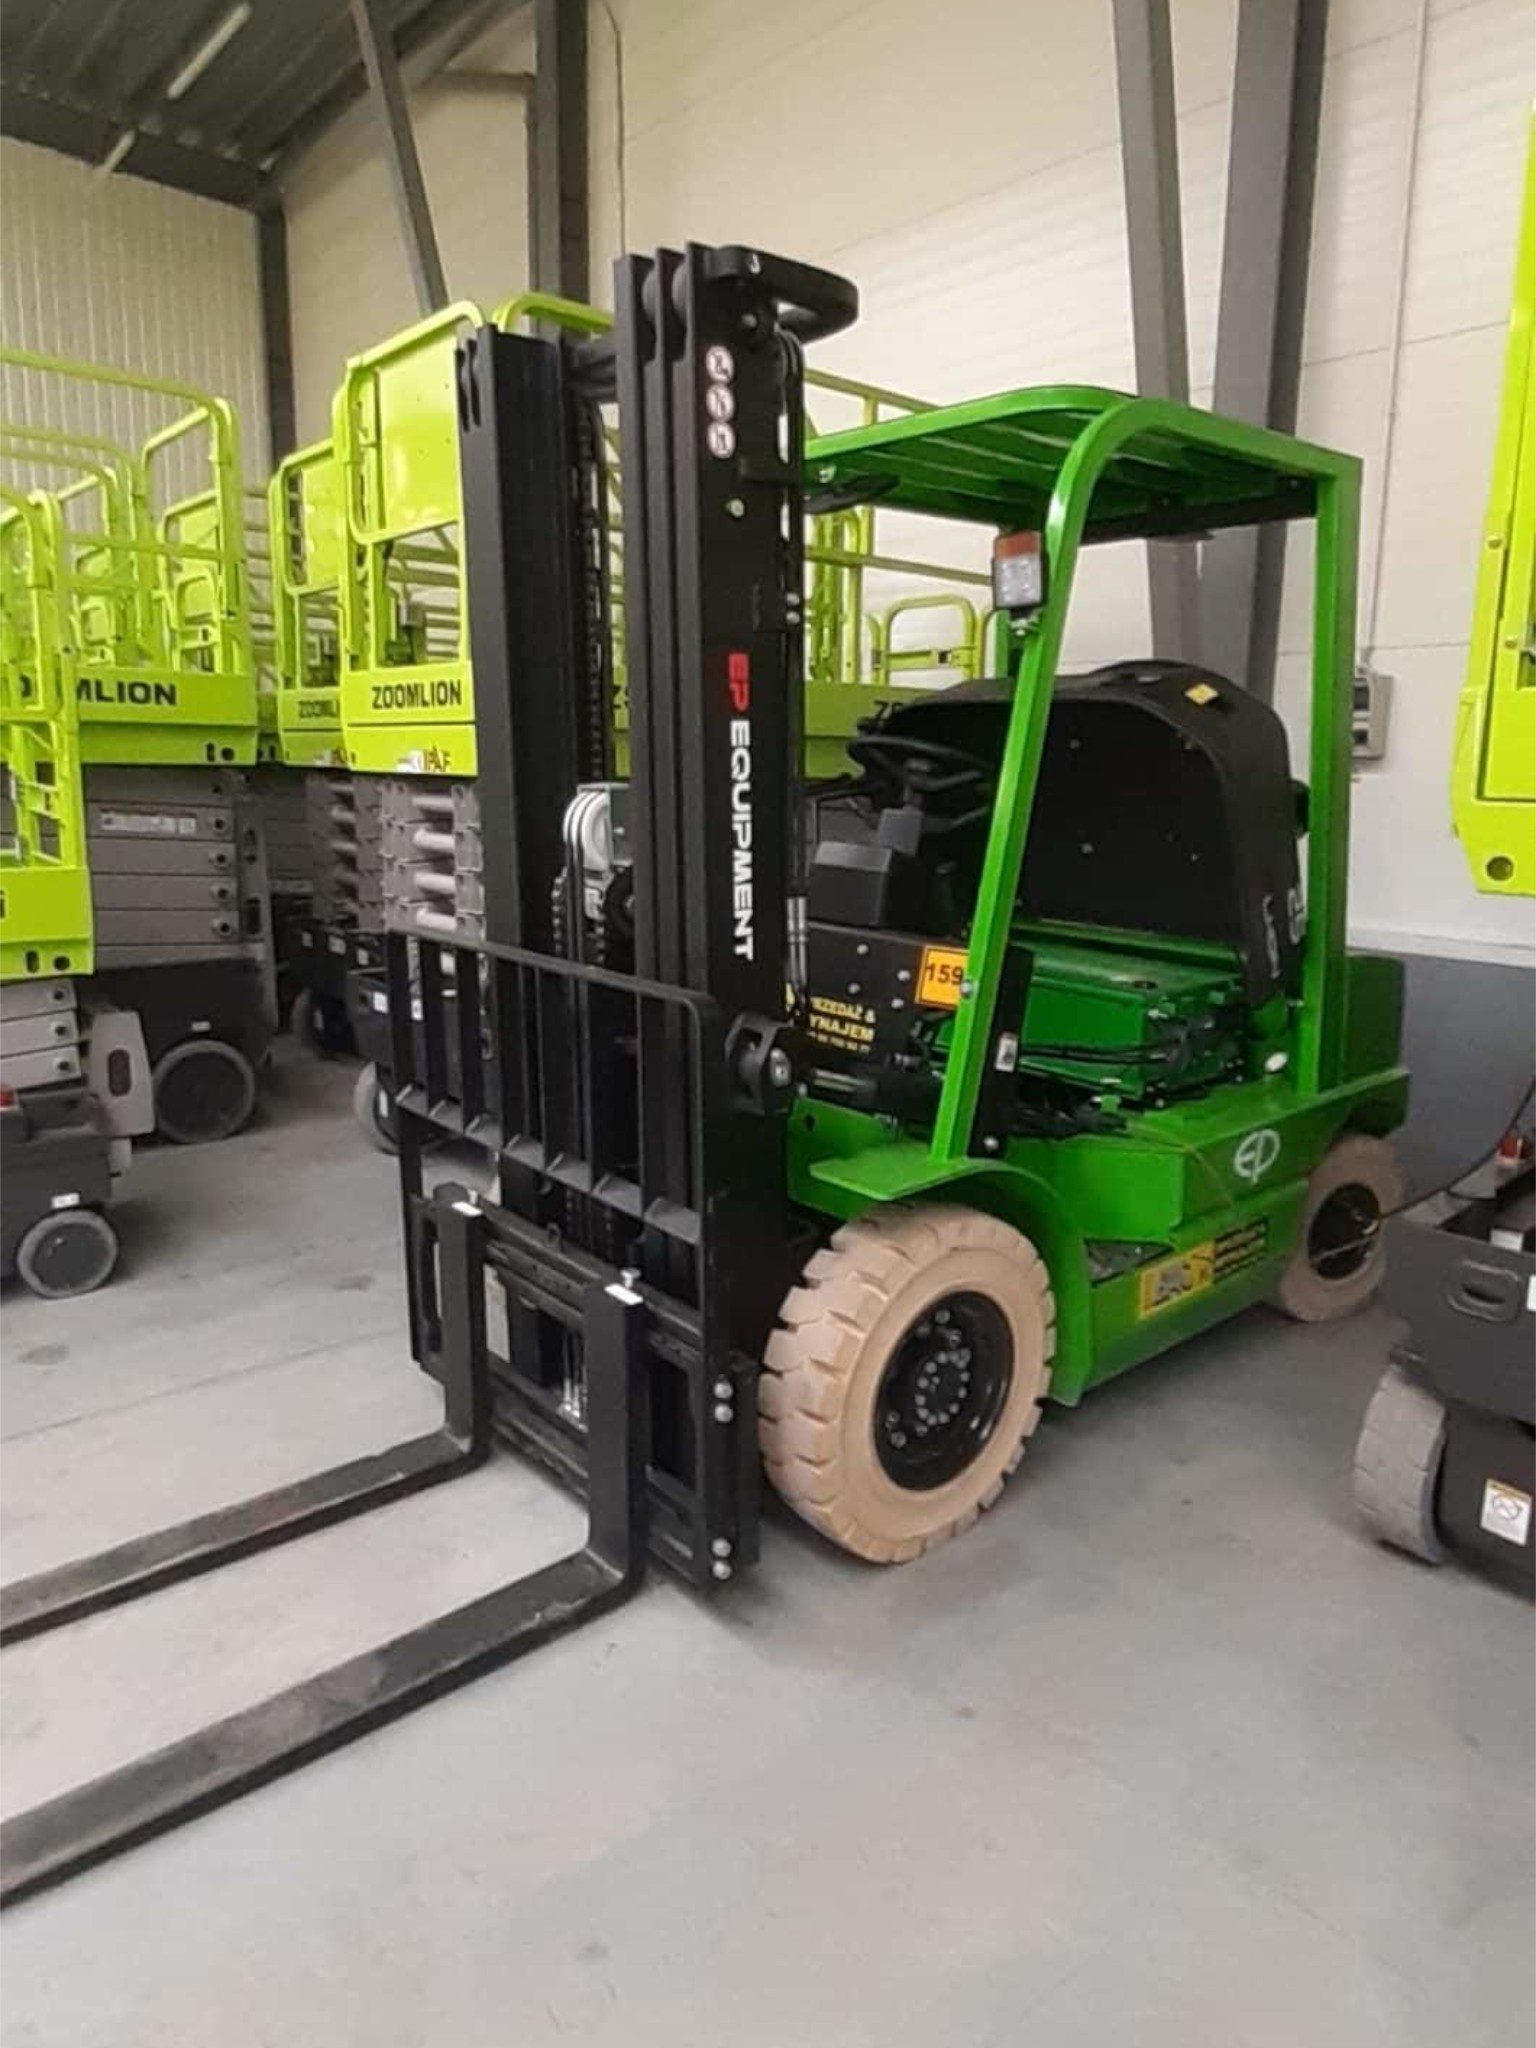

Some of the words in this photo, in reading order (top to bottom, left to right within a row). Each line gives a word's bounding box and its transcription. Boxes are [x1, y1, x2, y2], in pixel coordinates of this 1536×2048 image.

[371, 679, 463, 709] ZOOMLION
[729, 653, 749, 711] EP
[730, 720, 753, 961] EQUIPMENT
